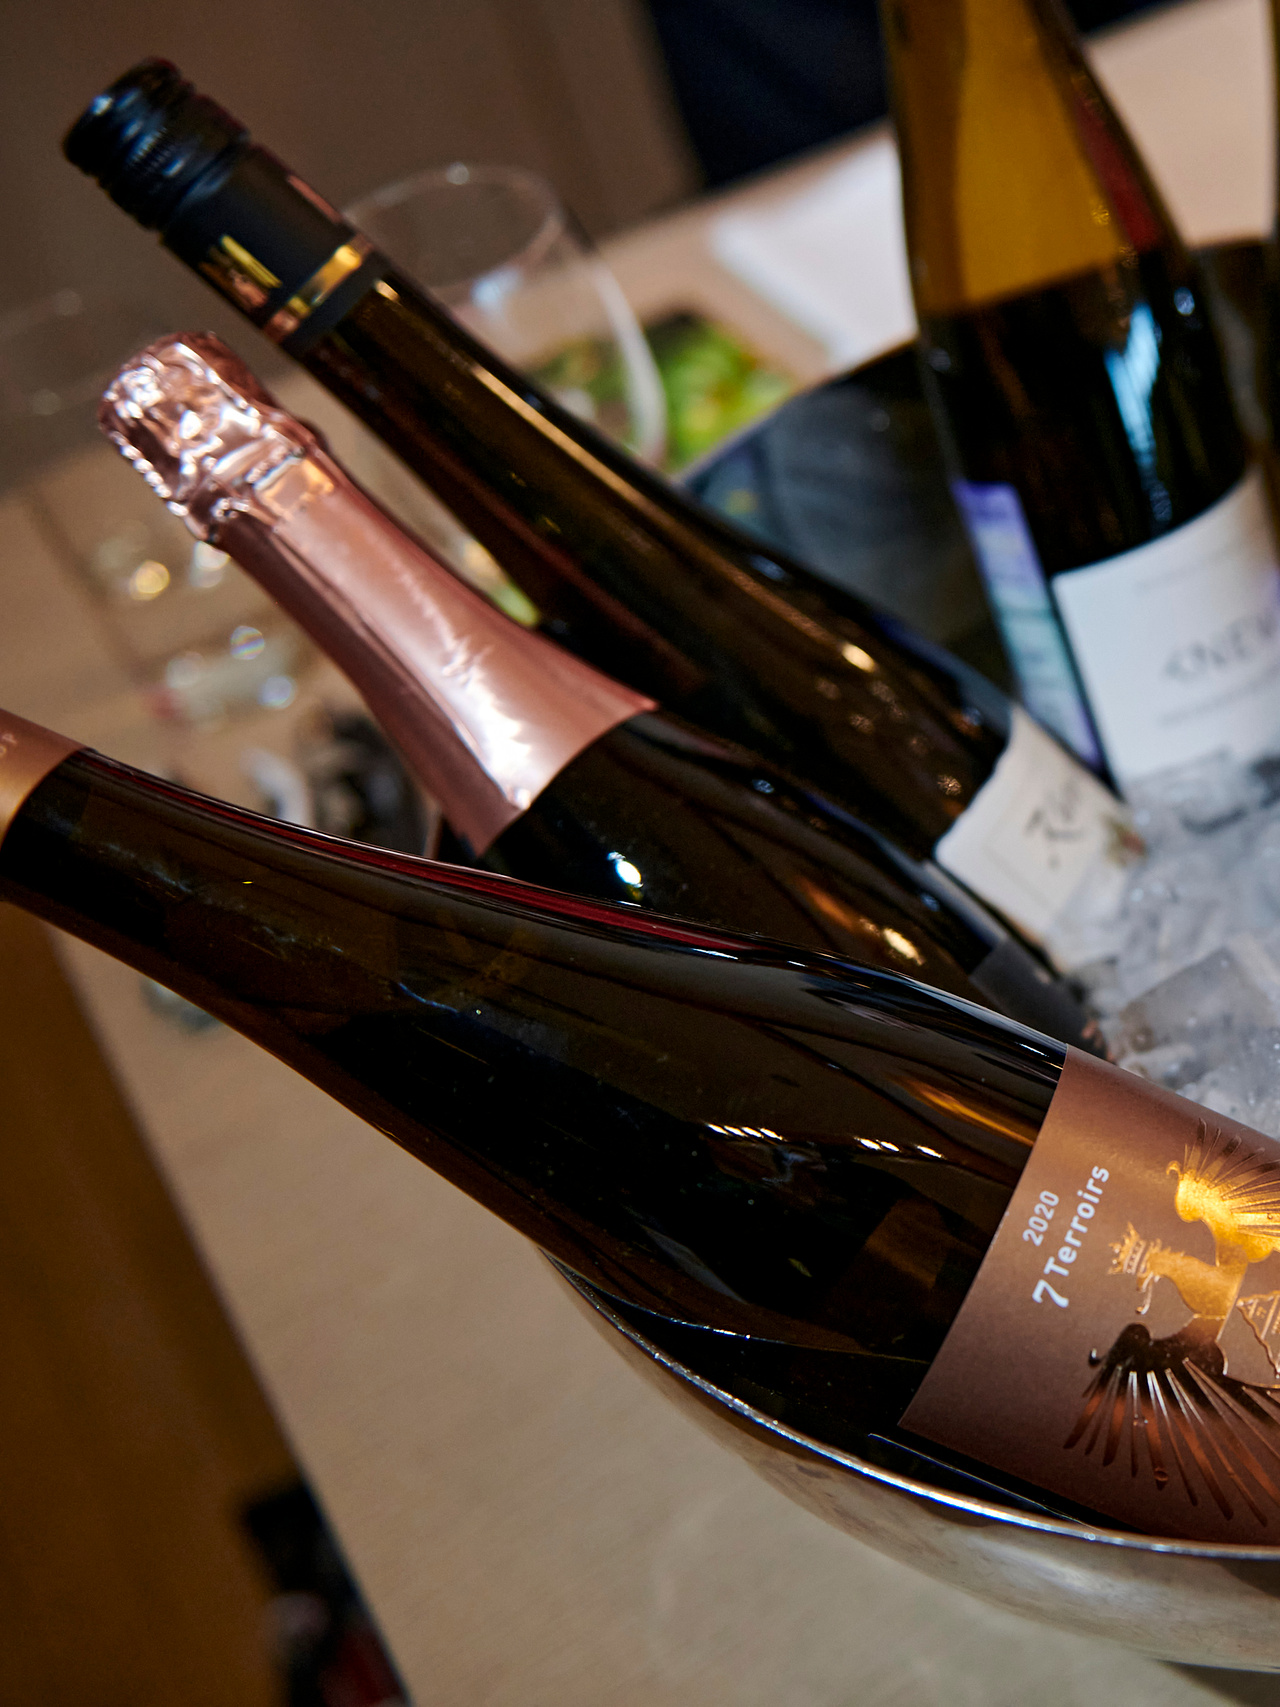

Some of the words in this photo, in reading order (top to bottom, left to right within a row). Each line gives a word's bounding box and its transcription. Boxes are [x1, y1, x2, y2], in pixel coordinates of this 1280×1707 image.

[1022, 1190, 1059, 1247] 2020
[1043, 1165, 1110, 1277] Terroirs
[1031, 1278, 1070, 1309] 7
